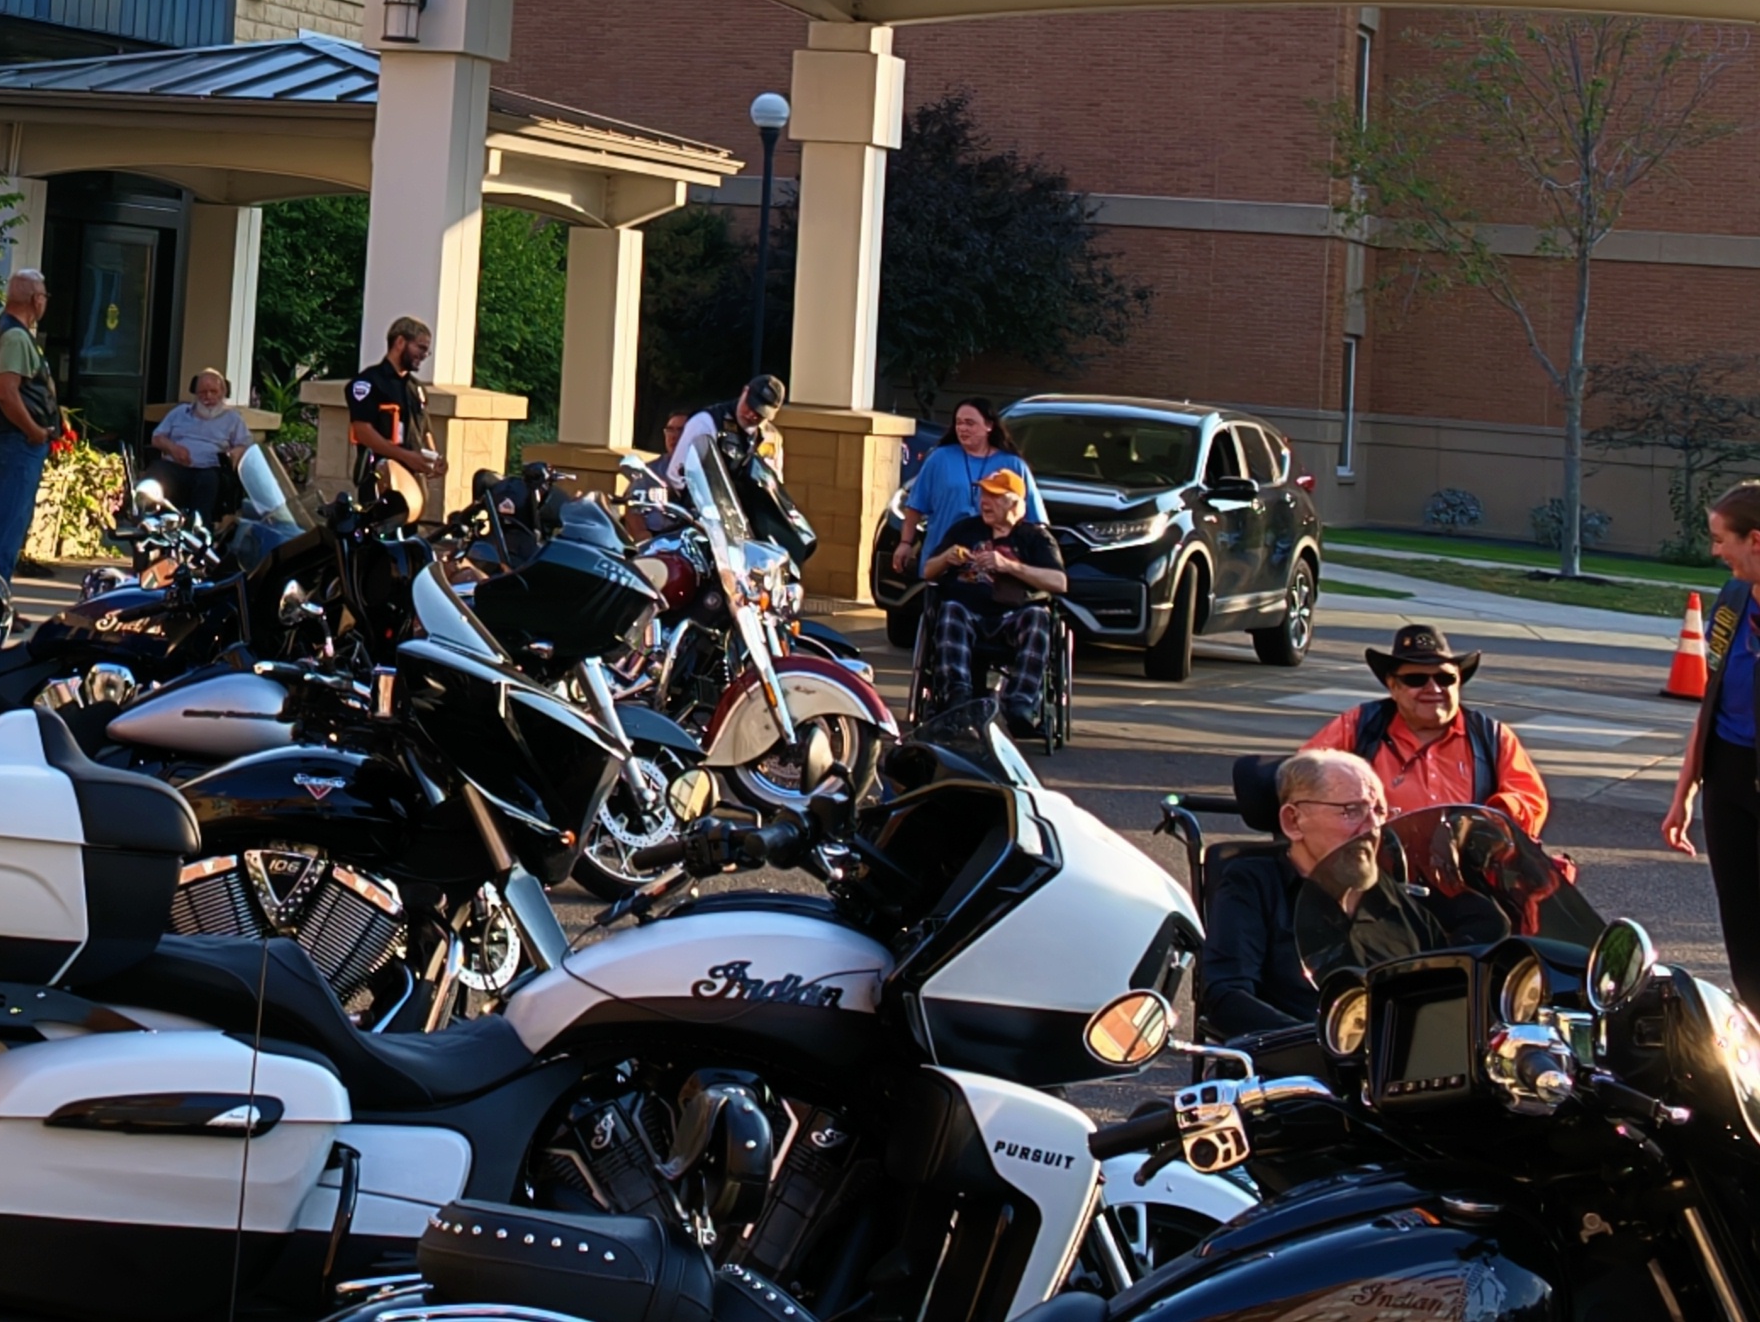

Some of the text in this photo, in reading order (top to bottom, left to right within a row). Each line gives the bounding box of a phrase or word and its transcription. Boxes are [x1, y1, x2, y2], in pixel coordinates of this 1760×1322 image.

[269, 859, 301, 874] 106
[691, 960, 844, 1008] Indian
[993, 1140, 1076, 1170] PURSUIT
[1350, 1282, 1442, 1312] Indian
